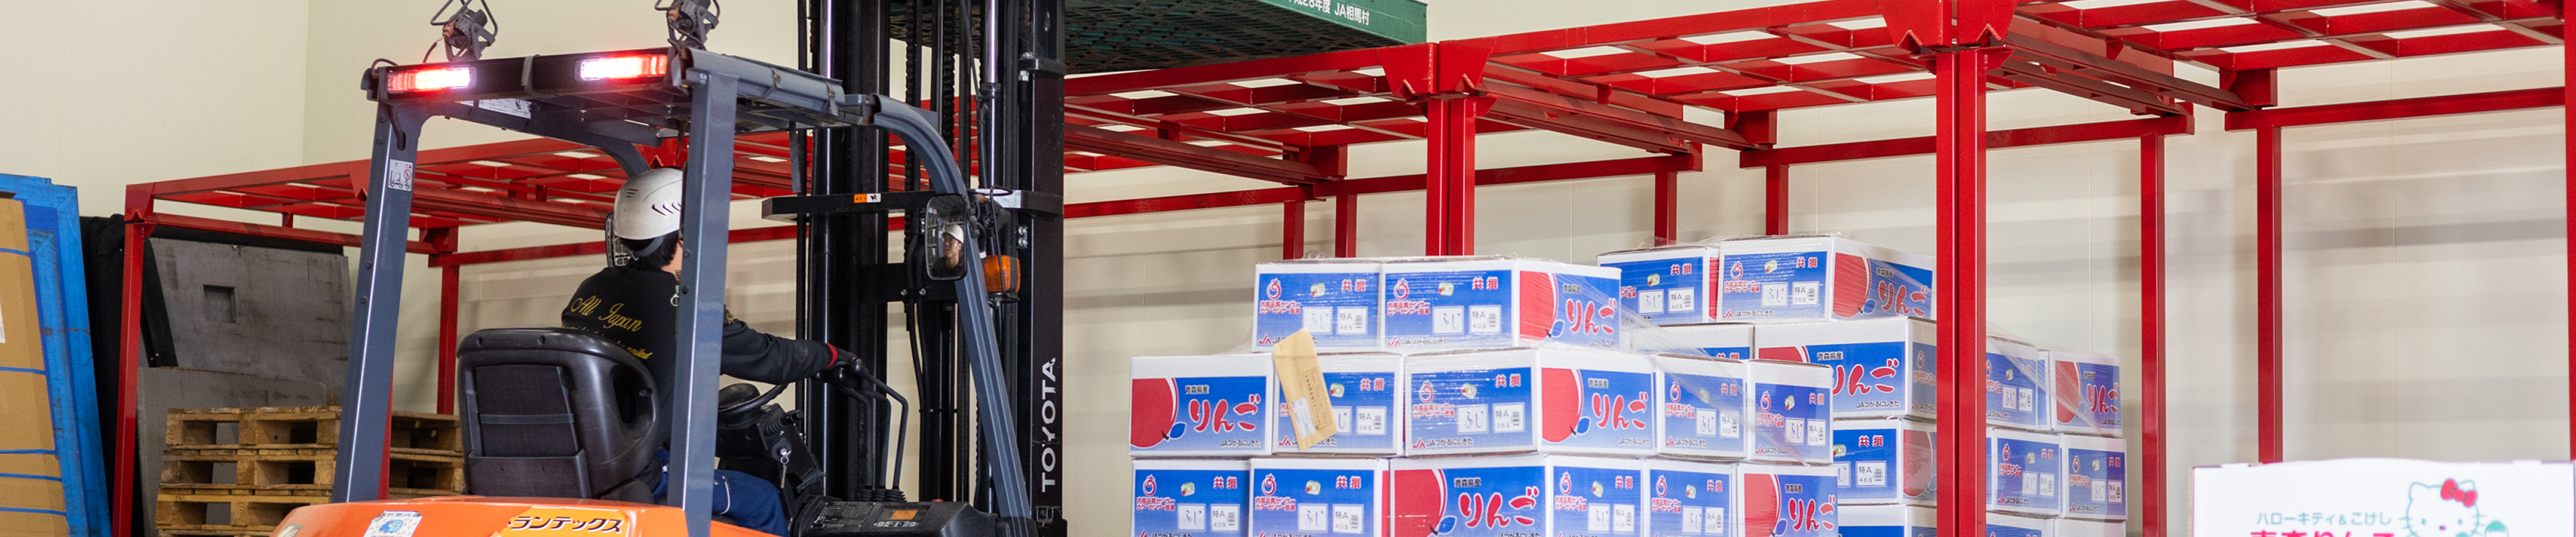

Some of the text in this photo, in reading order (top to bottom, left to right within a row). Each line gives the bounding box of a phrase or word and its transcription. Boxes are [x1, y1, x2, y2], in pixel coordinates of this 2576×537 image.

[1334, 3, 1370, 26] JA相馬村
[571, 295, 602, 316] All
[598, 303, 642, 332] Japan
[1879, 281, 1928, 316] りんご
[1566, 298, 1617, 335] りんご
[1817, 352, 1843, 360] 青森県産
[1189, 393, 1260, 434] りんご
[1592, 391, 1648, 431] りんご
[2086, 383, 2118, 415] りんご
[1042, 358, 1056, 493] TOYOTA
[1338, 413, 1347, 429] じ
[1427, 438, 1473, 446] JAつがるにしきた
[1838, 467, 1846, 482] じ
[1458, 486, 1540, 529] りんご
[1788, 494, 1836, 532] りんご
[2257, 512, 2392, 526] ハローキティ&こけし
[511, 516, 623, 534] ランテックス
